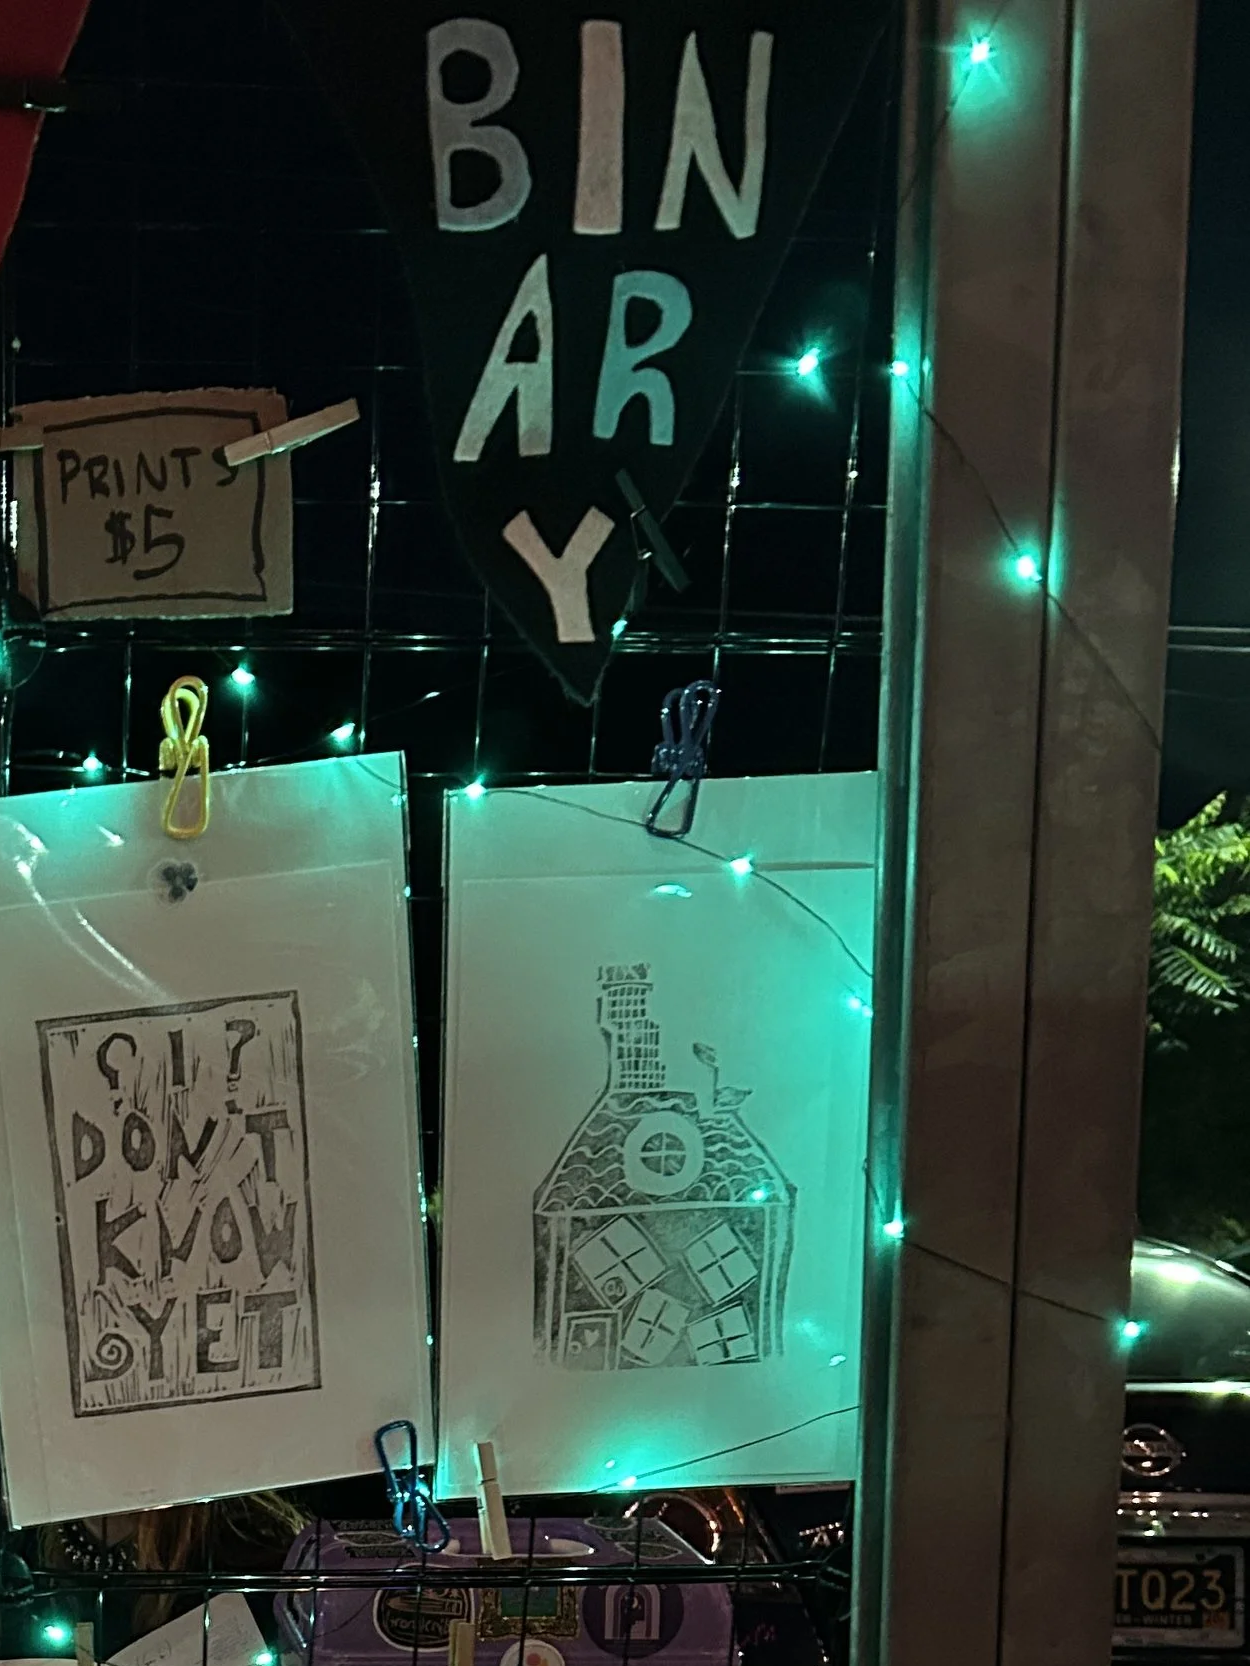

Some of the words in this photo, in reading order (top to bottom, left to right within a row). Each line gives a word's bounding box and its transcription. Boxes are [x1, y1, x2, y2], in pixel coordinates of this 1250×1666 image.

[426, 18, 773, 239] BIN
[453, 253, 693, 462] AR
[58, 444, 239, 505] PRINTS
[104, 505, 186, 578] $5
[502, 505, 616, 644] Y
[95, 1194, 298, 1287] KNOW
[126, 1287, 298, 1380] YET
